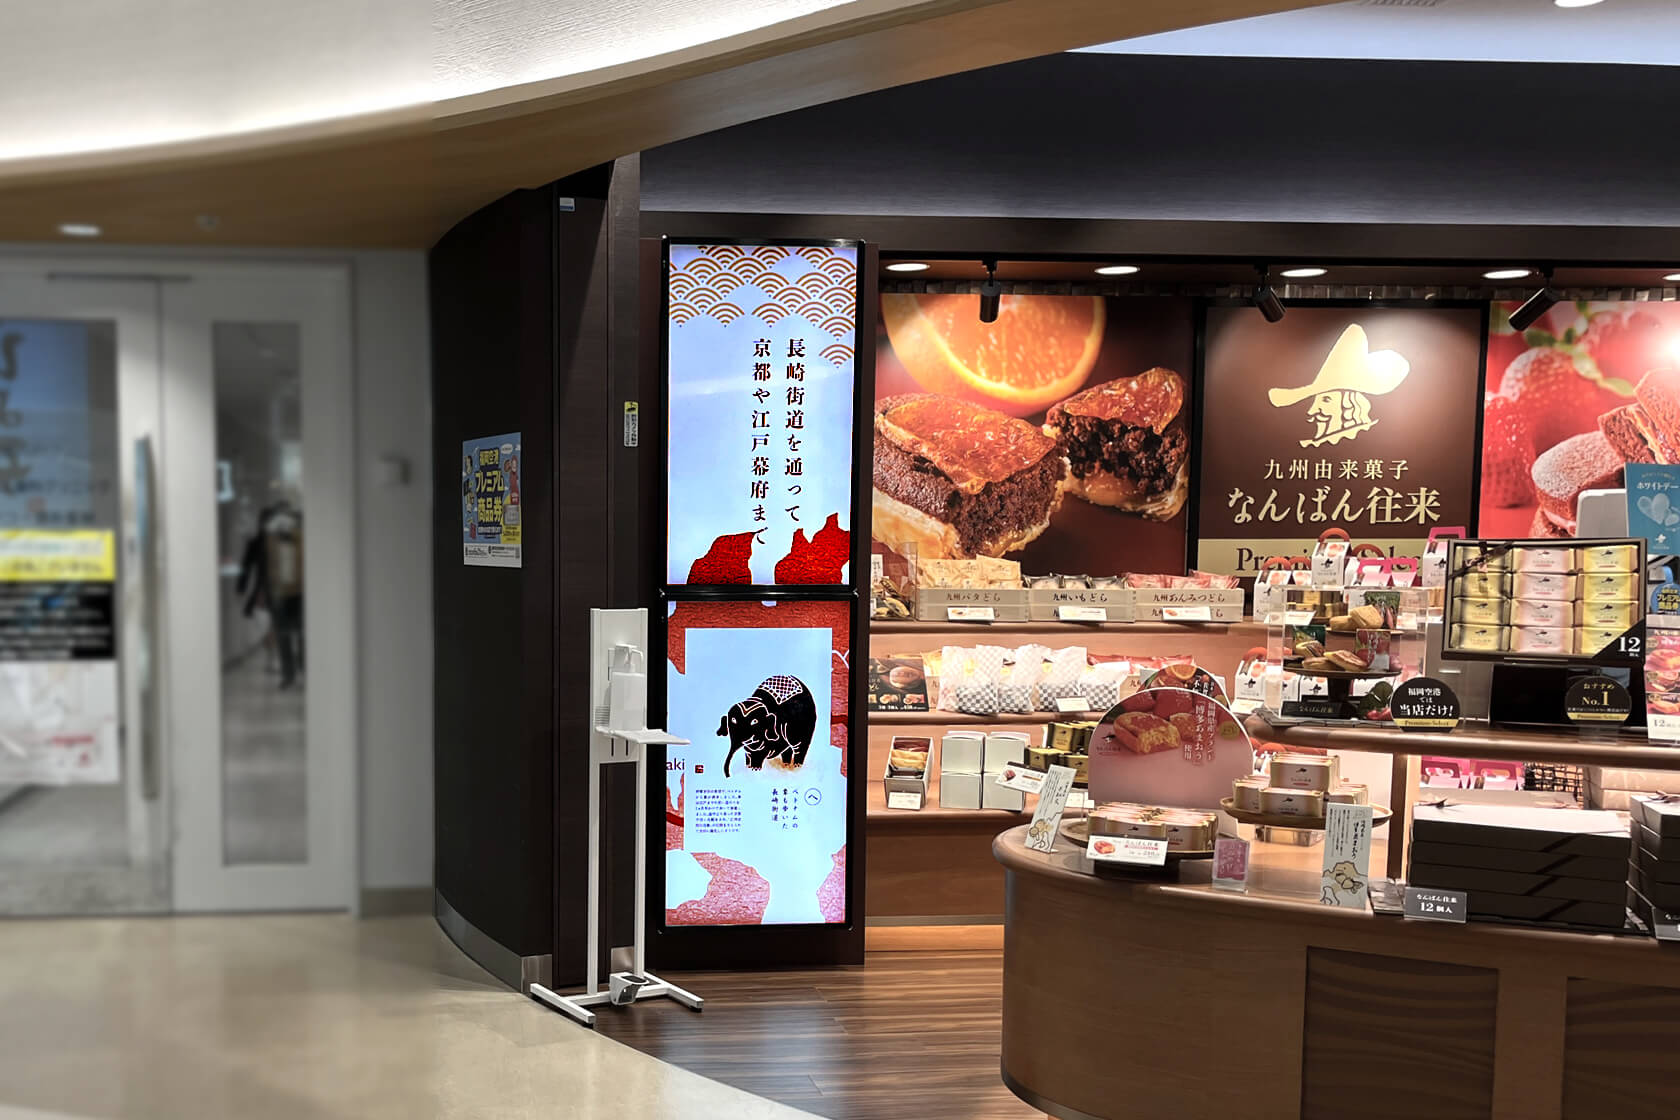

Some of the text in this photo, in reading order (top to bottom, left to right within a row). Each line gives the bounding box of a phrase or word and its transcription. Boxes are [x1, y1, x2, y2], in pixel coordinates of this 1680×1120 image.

[784, 338, 806, 522] 長崎街道を通って
[750, 338, 772, 545] 京都や江戸幕府まで
[1264, 459, 1409, 480] 九州由来菓子
[475, 471, 505, 493] プレミアム
[1636, 481, 1680, 491] ホワイトデー
[477, 496, 503, 523] 商品券
[1228, 485, 1441, 524] なんばん往来
[1053, 592, 1108, 603] 九州いもどら
[1153, 592, 1225, 603] 九州あんみつどら
[1619, 636, 1641, 653] 12
[1408, 687, 1441, 697] 福岡空港
[1582, 691, 1610, 706] No.1
